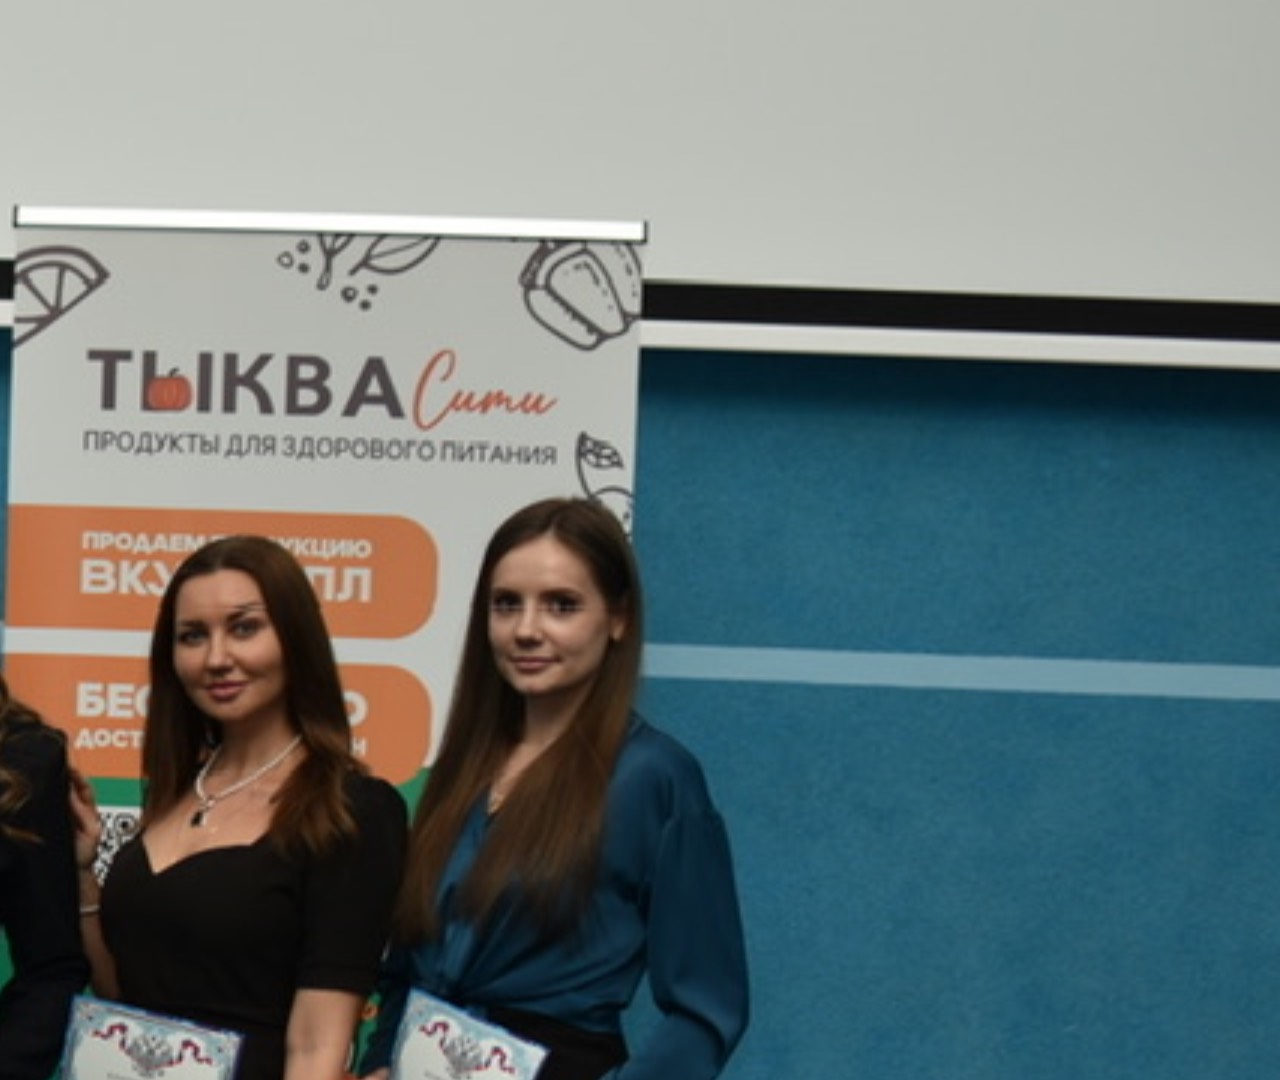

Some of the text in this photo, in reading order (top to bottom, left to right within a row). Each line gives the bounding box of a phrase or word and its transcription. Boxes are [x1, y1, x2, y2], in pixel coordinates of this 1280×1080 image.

[87, 348, 559, 432] ТЫКВА Сити
[83, 431, 558, 466] ПРОДУКТЫ ДЛЯ ЗДОРОВОГО ПИТАНИЯ
[82, 531, 208, 555] ПРОДАЕМ
